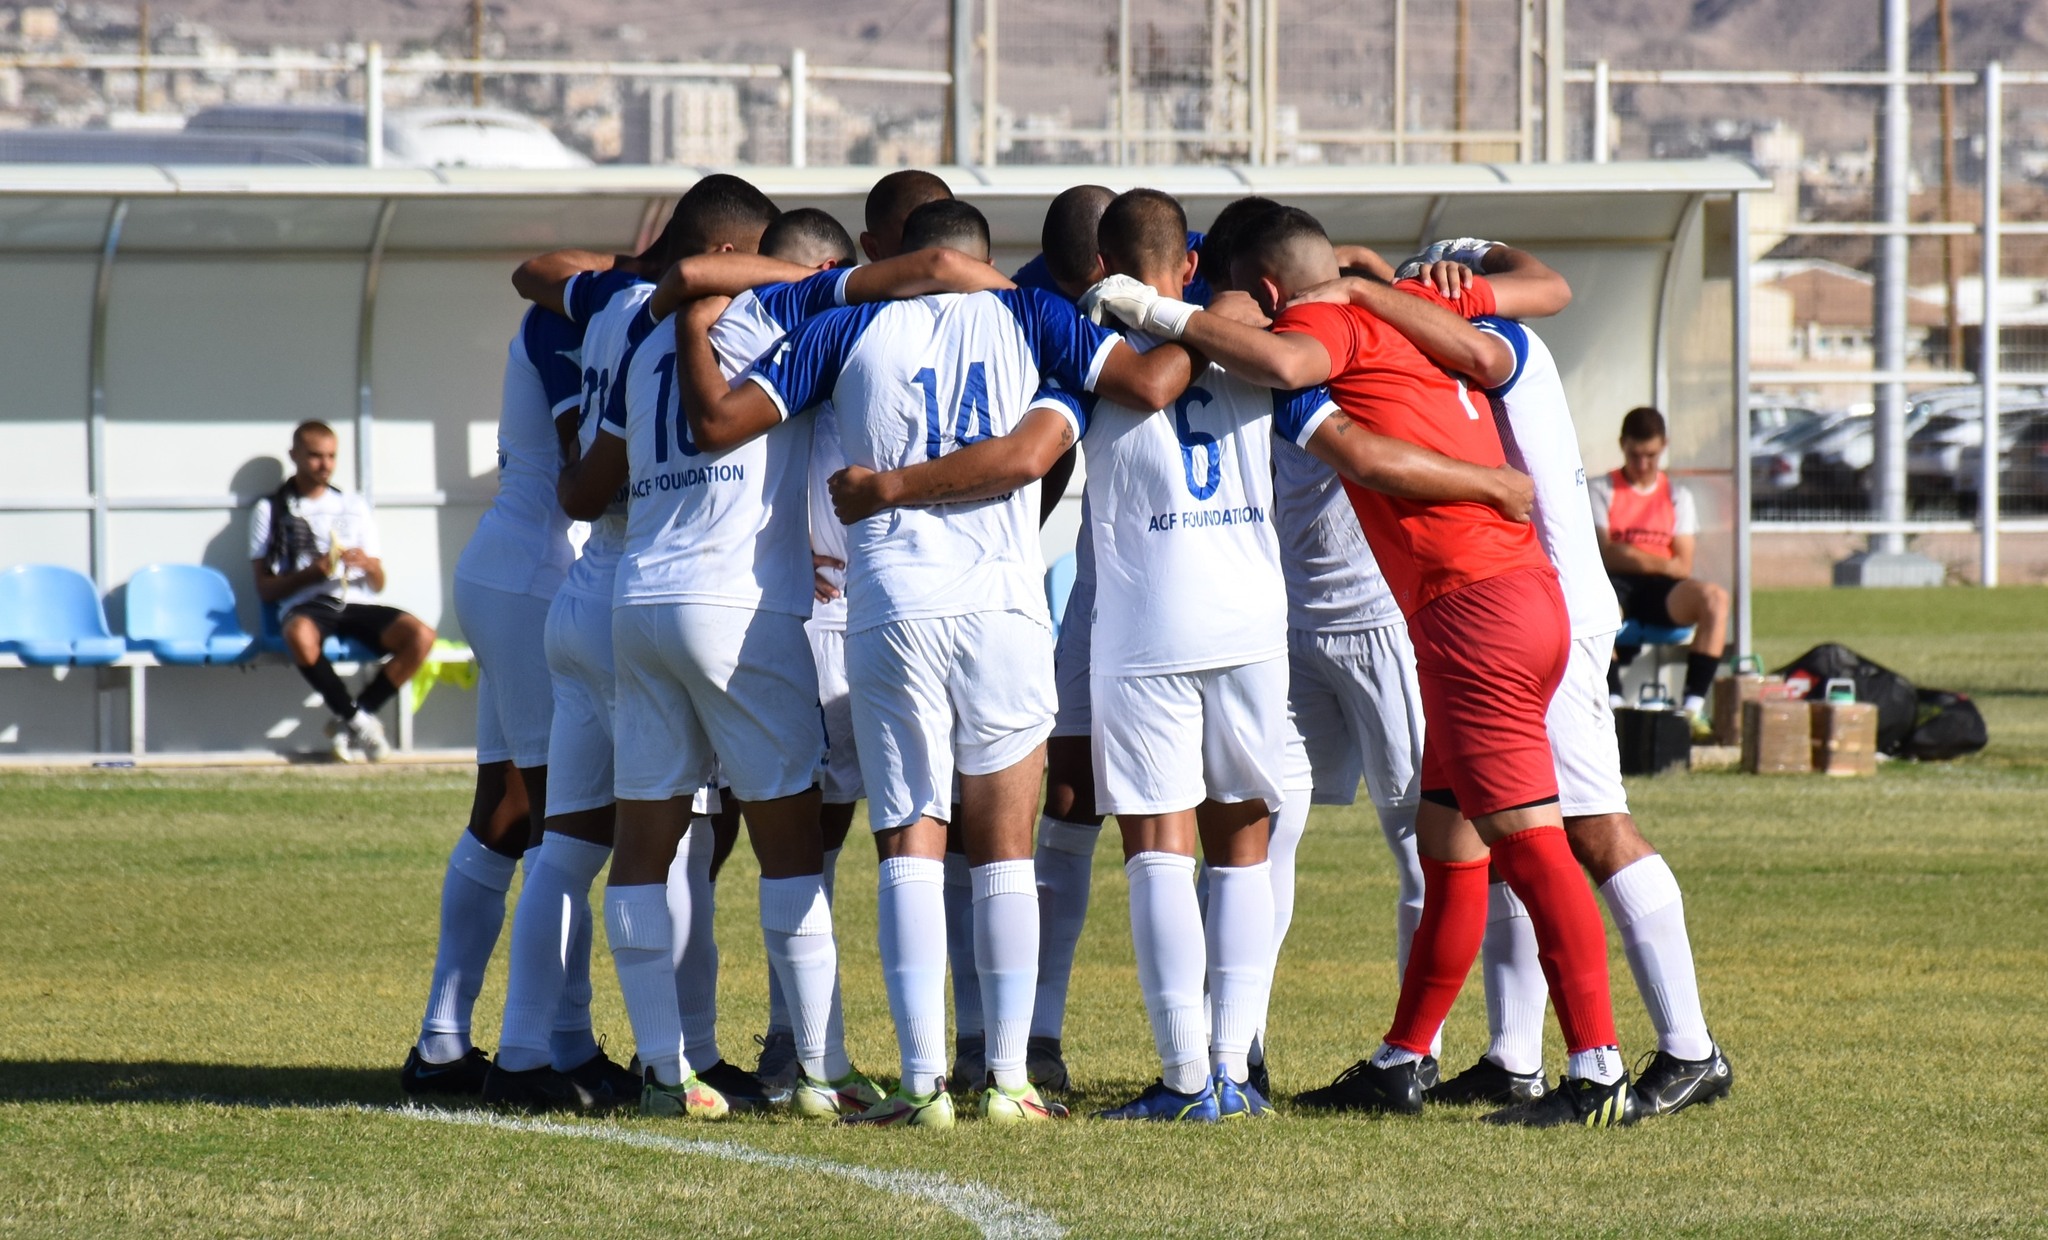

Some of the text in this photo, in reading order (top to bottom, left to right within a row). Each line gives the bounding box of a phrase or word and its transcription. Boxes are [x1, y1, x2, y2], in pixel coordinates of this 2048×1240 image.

[1174, 385, 1221, 501] 6
[631, 478, 652, 498] ACF
[655, 464, 744, 493] FOUNDATION
[1148, 506, 1264, 532] ACF FOUNDATION
